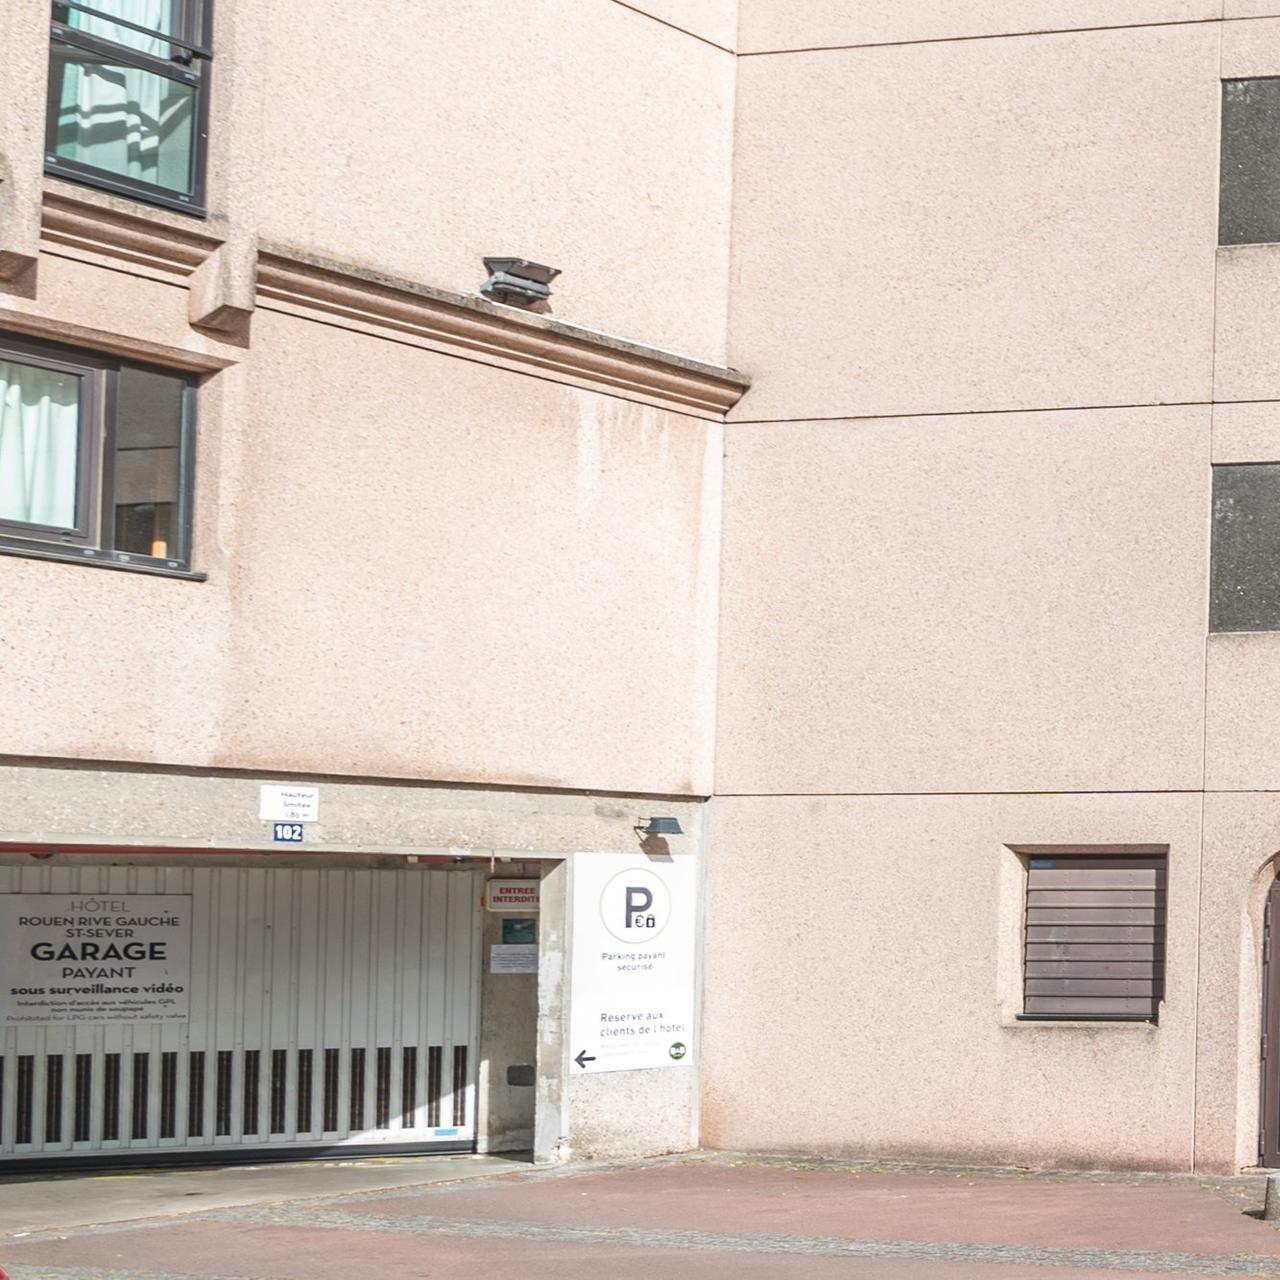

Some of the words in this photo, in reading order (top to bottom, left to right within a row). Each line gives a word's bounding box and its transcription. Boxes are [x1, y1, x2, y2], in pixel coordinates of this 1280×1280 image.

[275, 824, 302, 840] 102
[70, 898, 131, 912] HÔTEL
[18, 916, 75, 927] ROUEN
[78, 916, 112, 927] RIVE
[115, 916, 180, 927] GAUCHE
[66, 928, 135, 938] ST-SEVER
[30, 942, 168, 961] GARAGE
[601, 952, 636, 961] Parking
[638, 952, 666, 960] payant
[62, 966, 137, 979] PAYANT
[10, 987, 46, 995] sous
[49, 983, 140, 995] surveillance
[143, 982, 184, 994] vidéo
[646, 1012, 663, 1020] aux
[600, 1026, 636, 1037] clients
[638, 1025, 651, 1034] de
